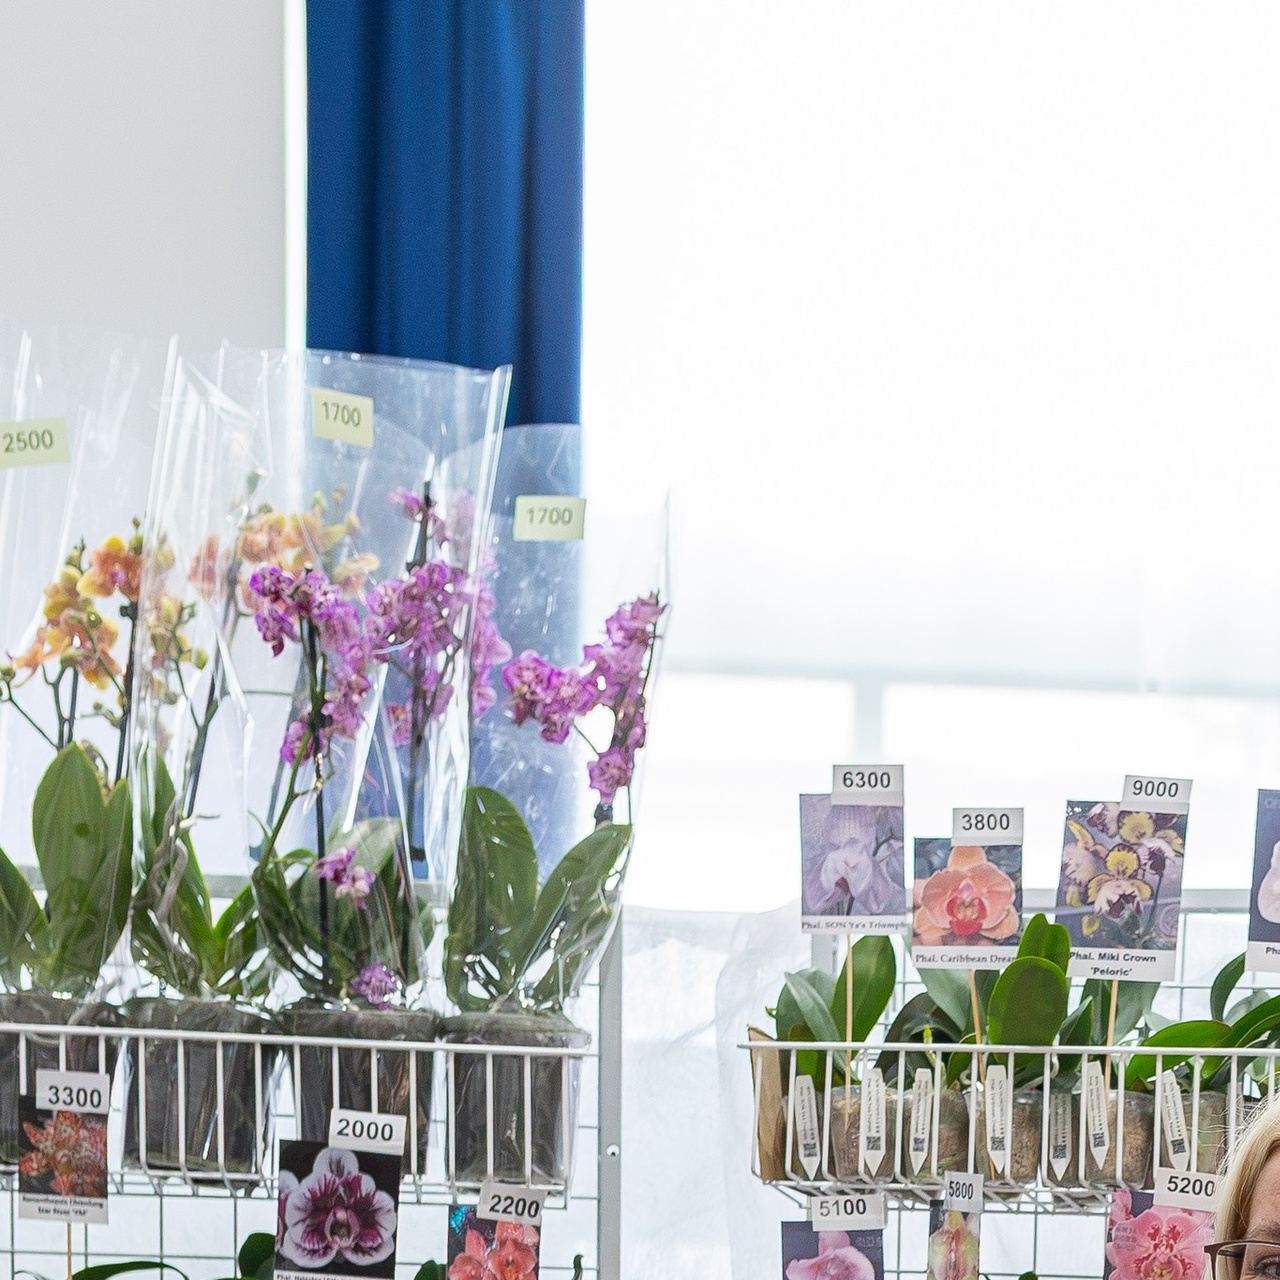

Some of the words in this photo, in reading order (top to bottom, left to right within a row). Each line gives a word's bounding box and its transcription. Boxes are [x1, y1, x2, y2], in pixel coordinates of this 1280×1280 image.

[321, 400, 361, 428] 1700
[2, 431, 53, 453] 2500
[527, 506, 573, 526] 1700
[843, 771, 891, 789] 6300
[1132, 780, 1179, 799] 9000
[962, 812, 1010, 831] 3800
[914, 953, 938, 964] Phal.
[1070, 951, 1096, 963] Phal.
[1123, 953, 1157, 963] Crown
[48, 1085, 102, 1108] 3300
[336, 1118, 394, 1141] 2000
[948, 1179, 973, 1200] 5800
[1167, 1174, 1214, 1198] 5200
[489, 1193, 540, 1219] 2200
[820, 1198, 867, 1218] 5100
